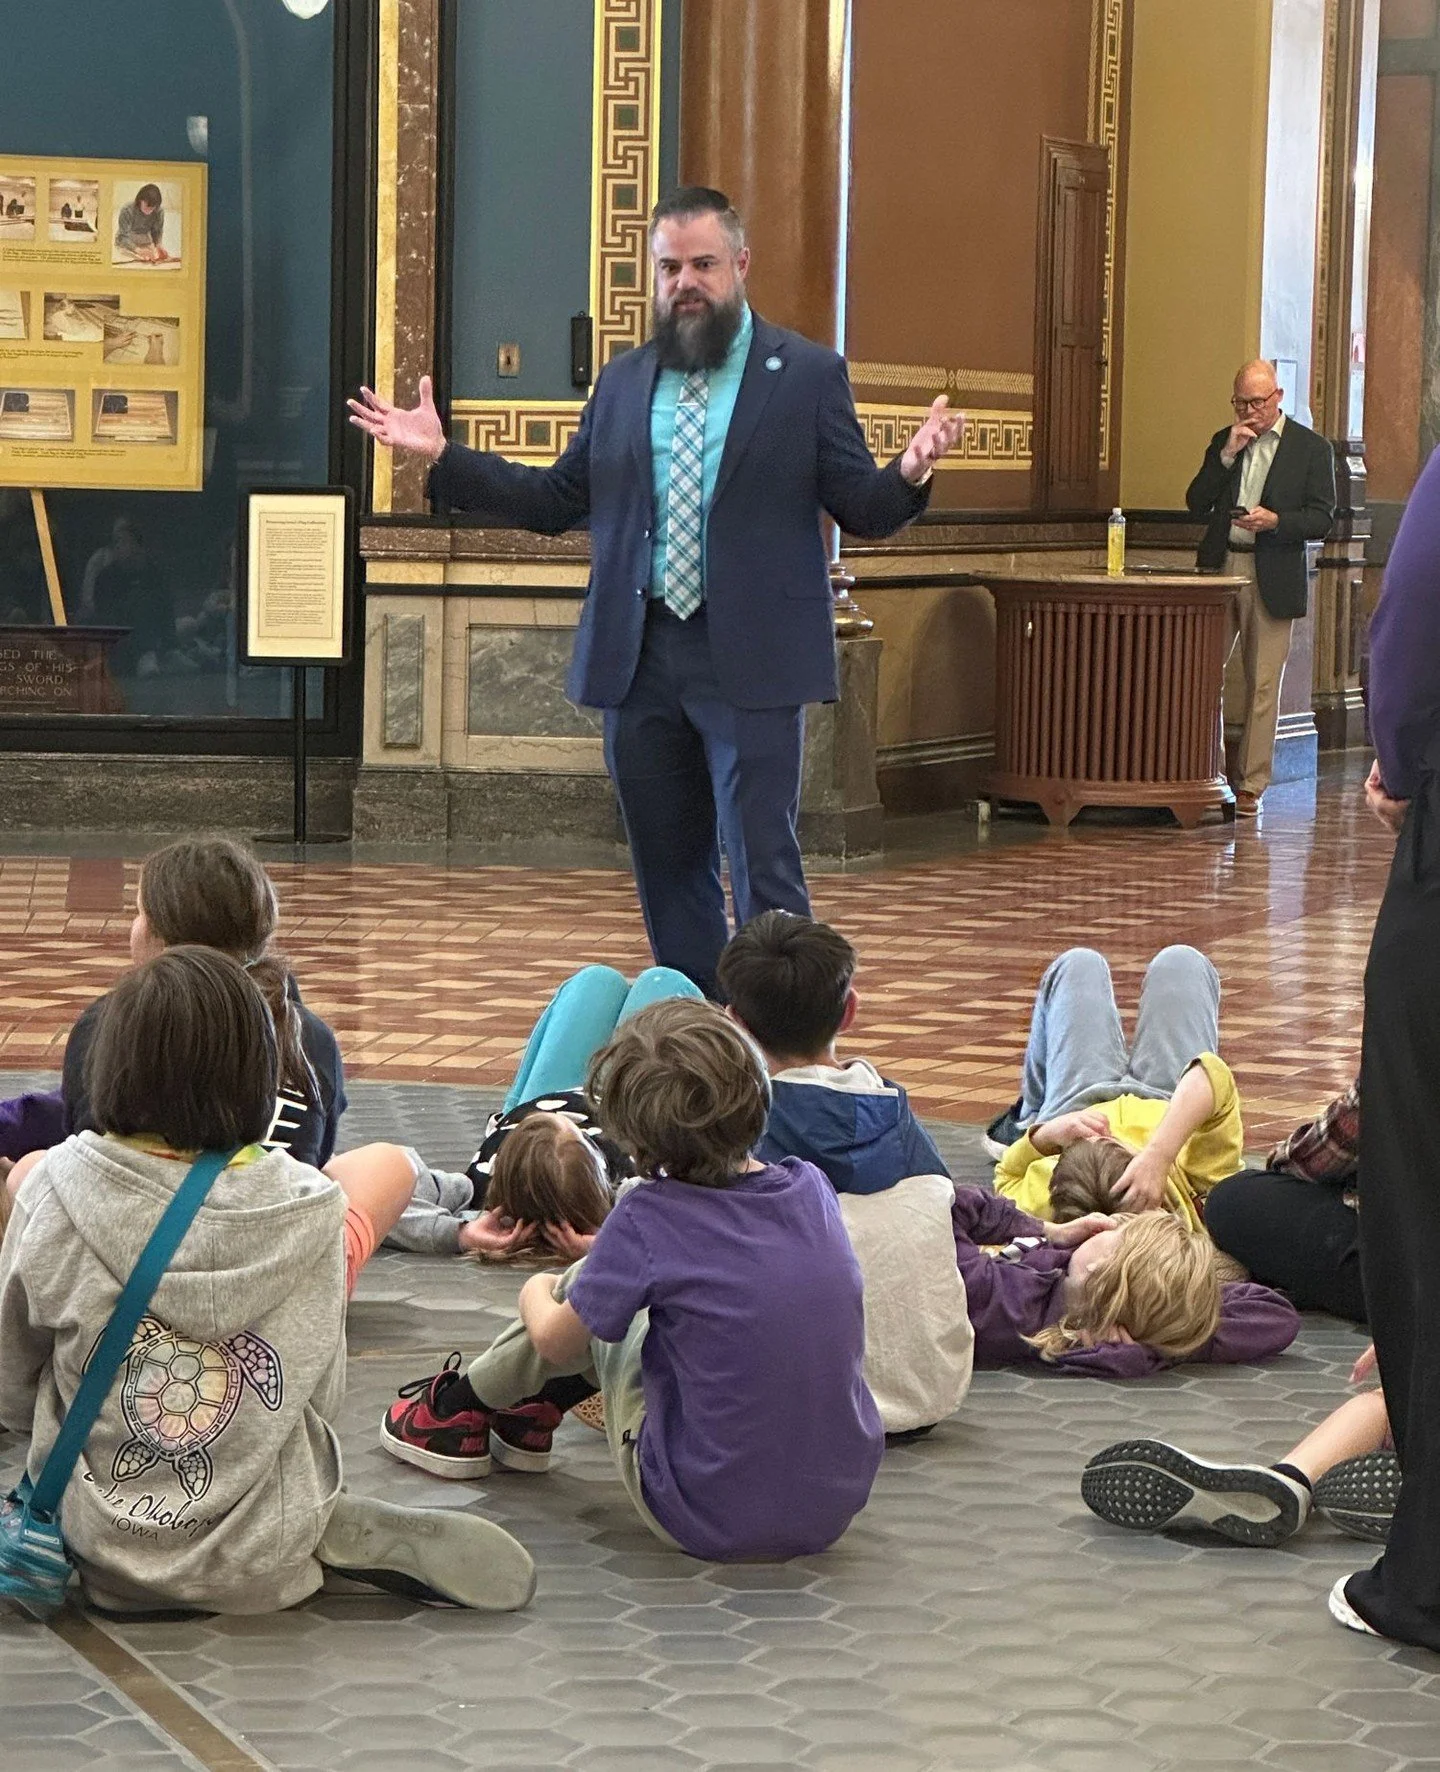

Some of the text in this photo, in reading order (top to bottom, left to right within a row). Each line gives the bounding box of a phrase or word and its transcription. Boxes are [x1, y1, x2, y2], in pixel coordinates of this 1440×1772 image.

[31, 649, 57, 660] THE
[25, 662, 42, 673] OF
[52, 662, 73, 673] HIS
[54, 686, 73, 698] ON
[111, 1513, 158, 1541] IOWA
